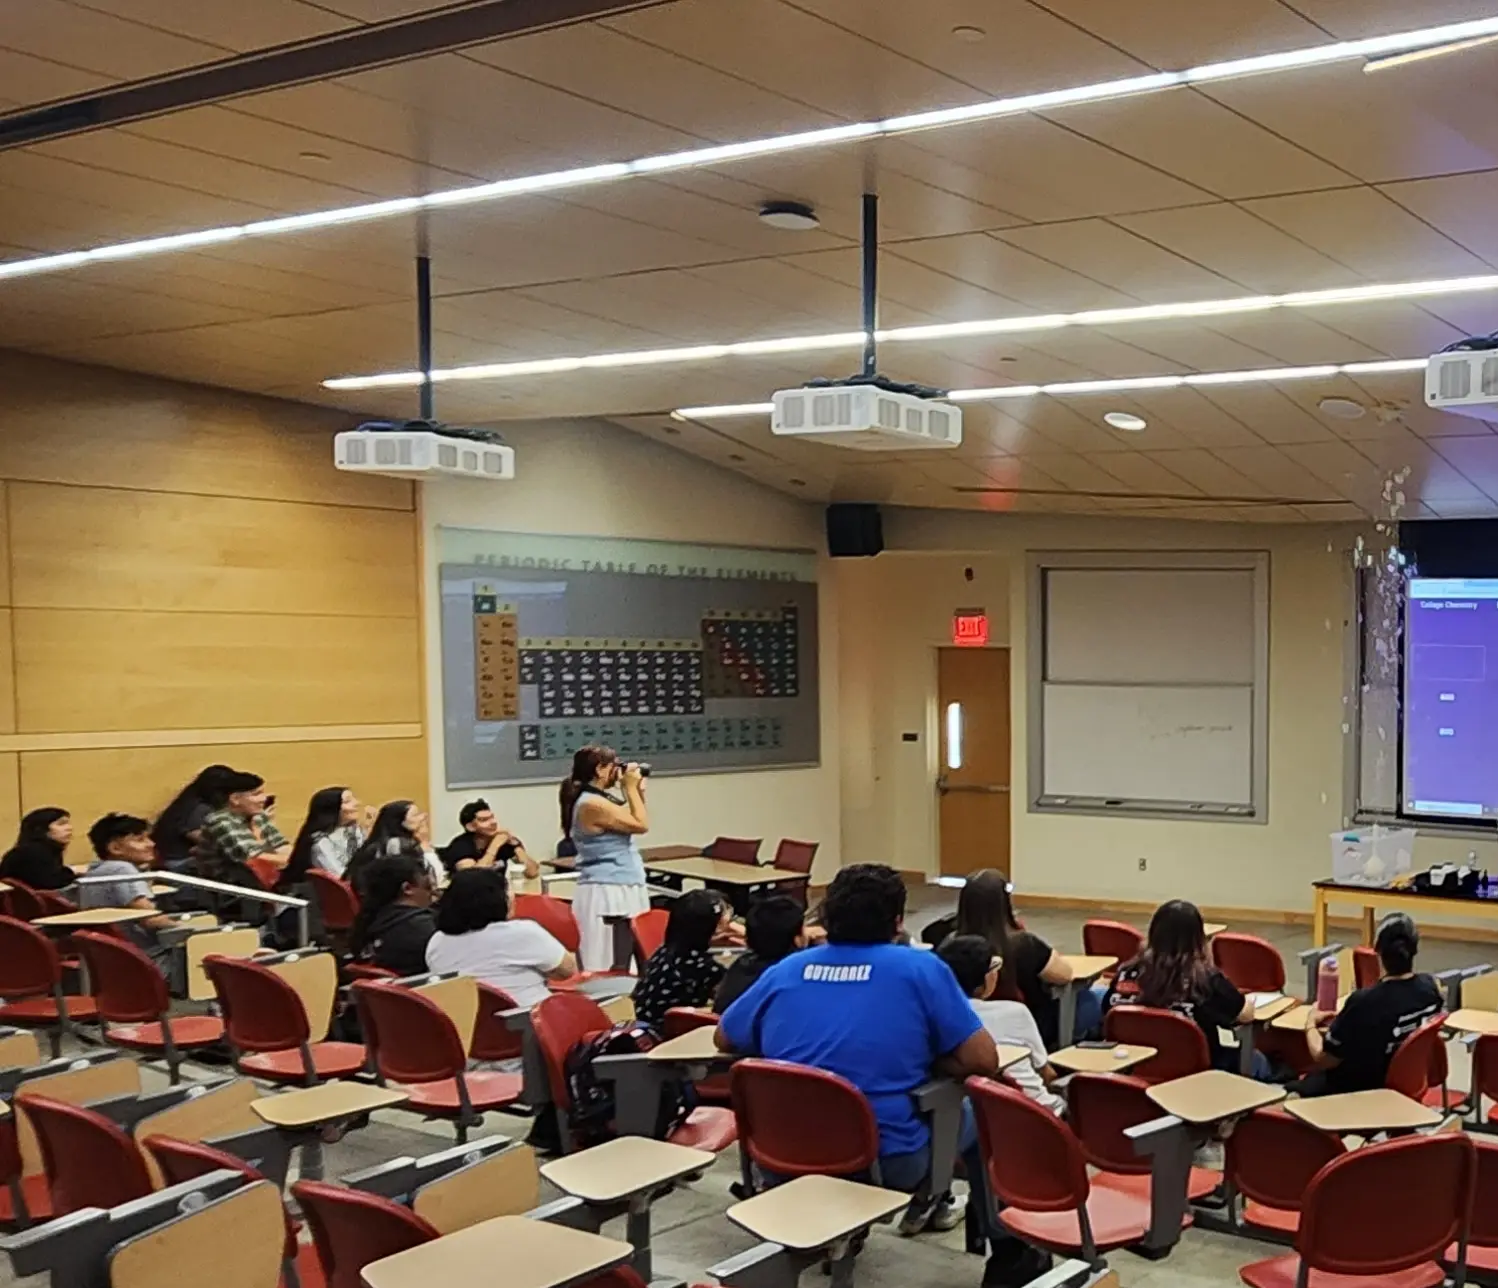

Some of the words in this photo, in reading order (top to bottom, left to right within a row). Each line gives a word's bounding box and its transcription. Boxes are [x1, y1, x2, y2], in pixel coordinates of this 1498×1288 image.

[473, 553, 572, 572] PERIODIC
[581, 558, 637, 574] TABLE
[803, 964, 872, 982] GUTIERREZ
